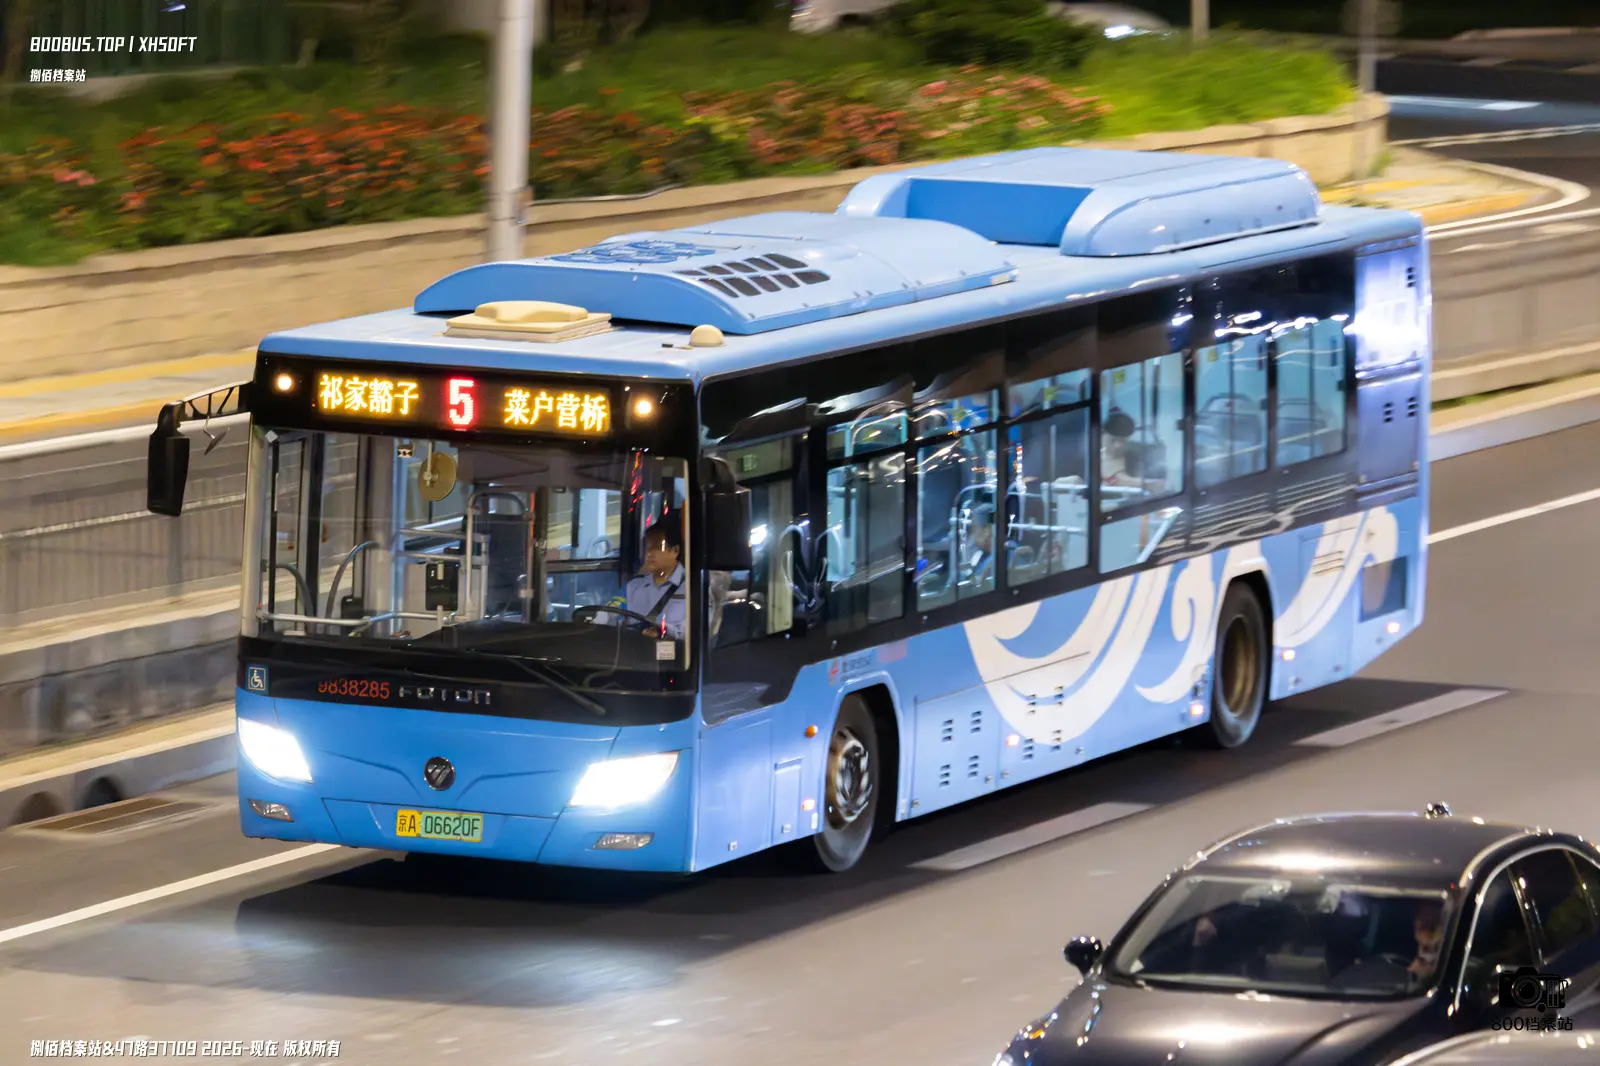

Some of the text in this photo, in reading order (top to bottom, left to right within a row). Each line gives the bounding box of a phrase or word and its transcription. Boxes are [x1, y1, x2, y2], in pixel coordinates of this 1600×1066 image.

[320, 374, 607, 431] 祁家豁子 5 菜户营桥
[317, 678, 391, 699] 9838285
[424, 815, 481, 837] 06620F
